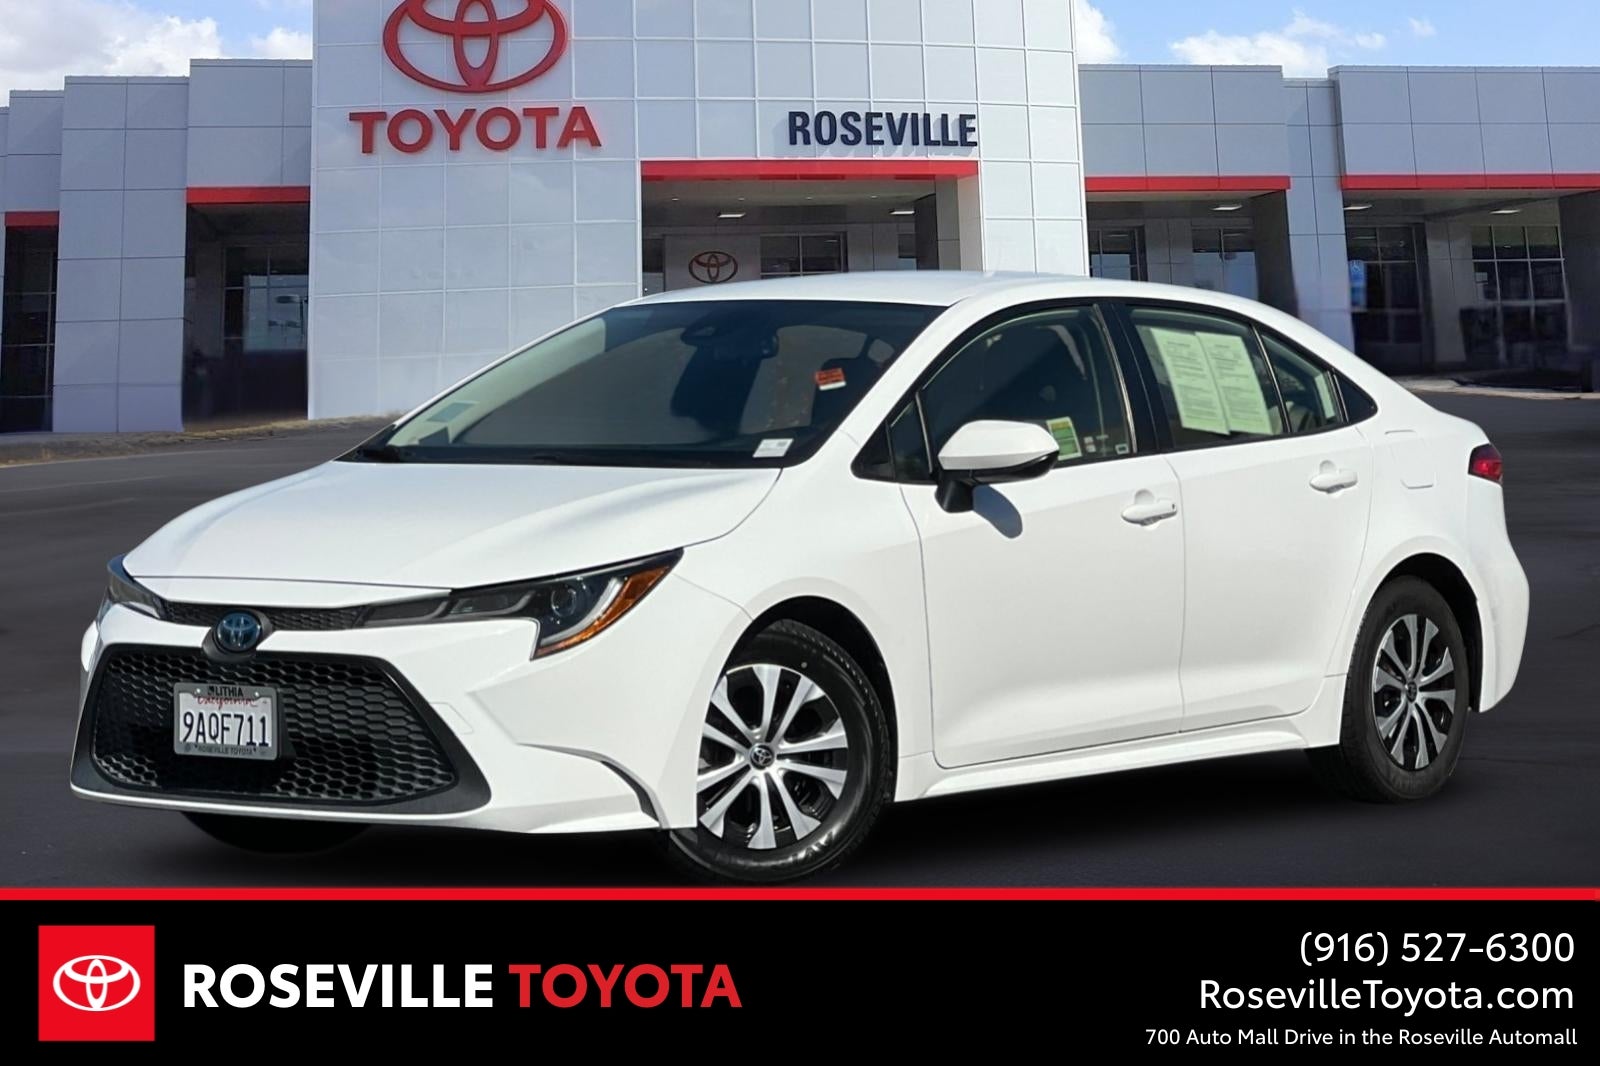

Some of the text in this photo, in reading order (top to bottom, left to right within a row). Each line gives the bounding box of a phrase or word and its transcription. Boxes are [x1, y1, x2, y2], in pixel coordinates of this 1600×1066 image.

[349, 106, 601, 154] TOYOTA
[788, 110, 978, 147] ROSEVILLE
[214, 685, 244, 698] LITHIA
[183, 711, 269, 747] 9AQF711
